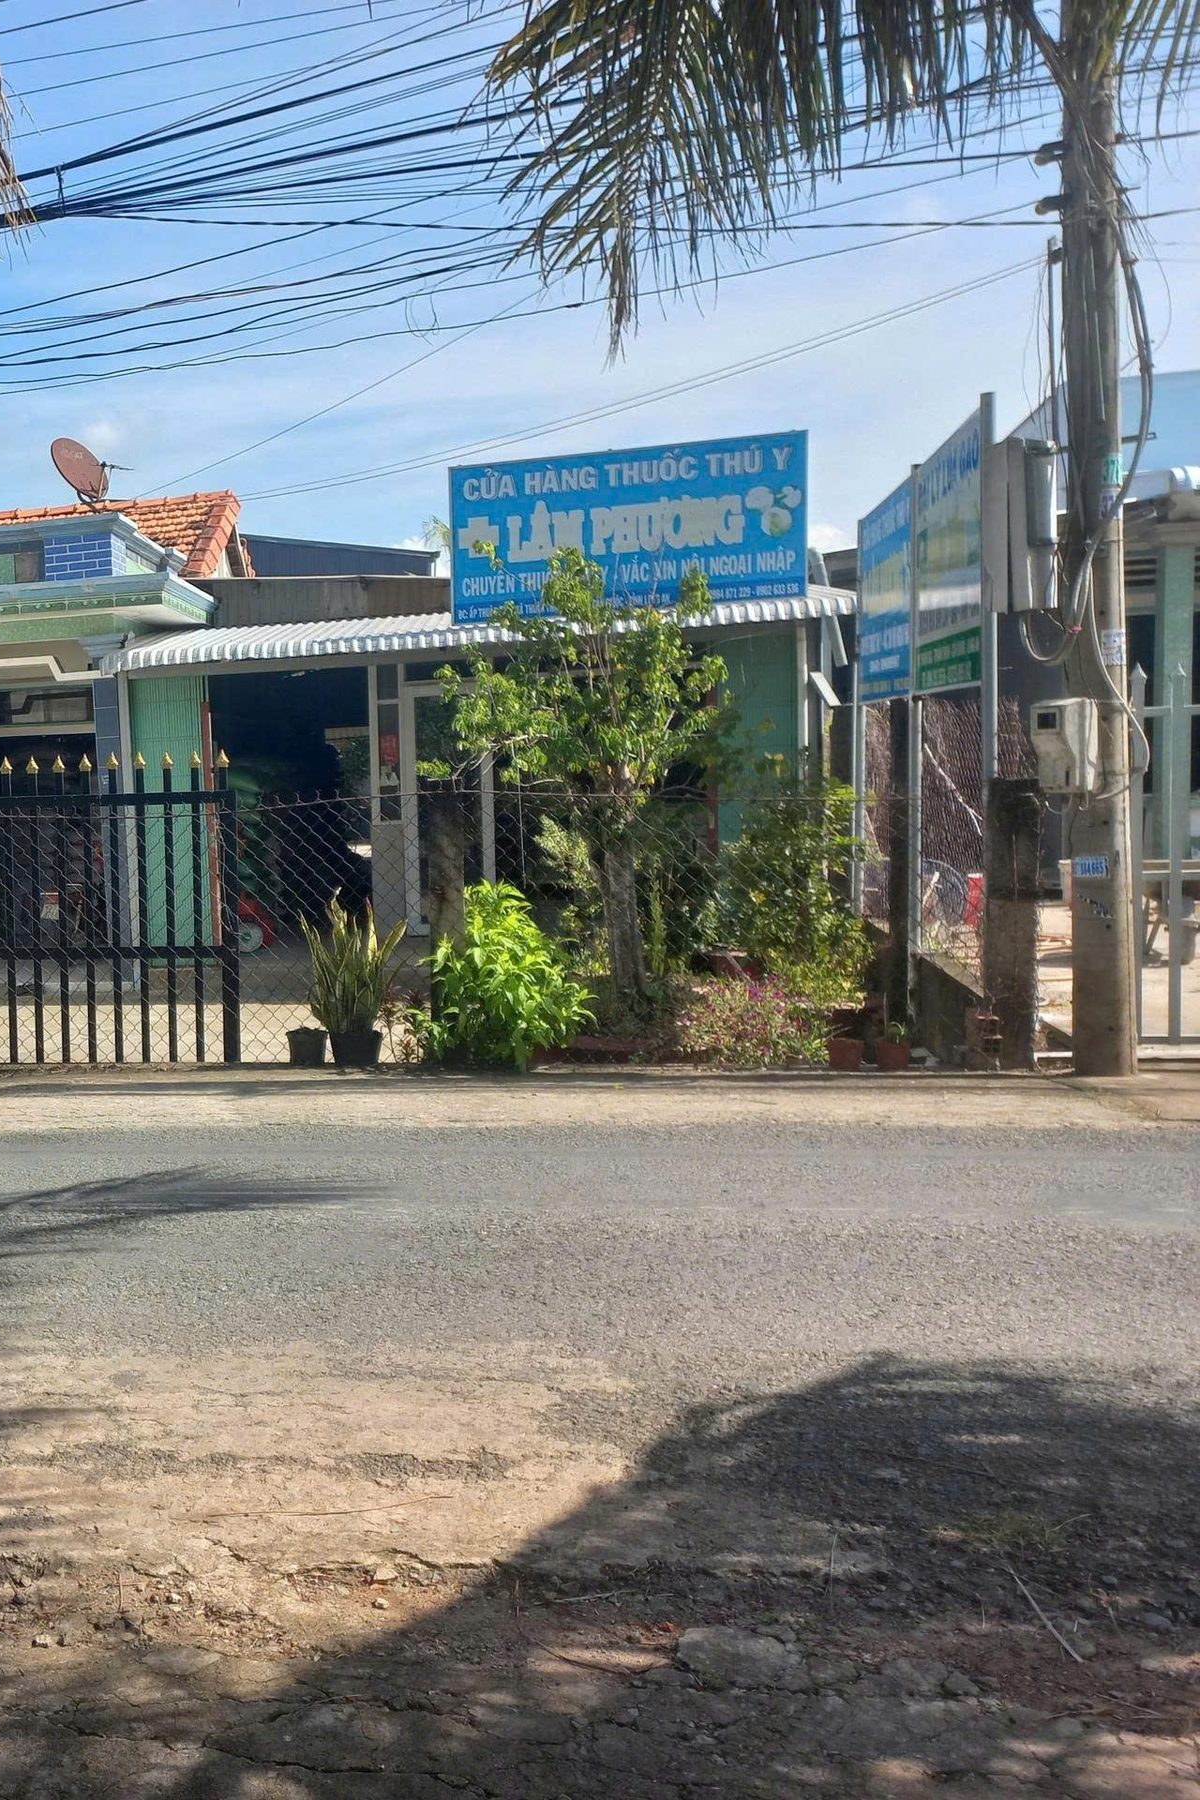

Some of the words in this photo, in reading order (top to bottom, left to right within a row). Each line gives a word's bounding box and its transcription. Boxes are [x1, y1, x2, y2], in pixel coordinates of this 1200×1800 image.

[463, 468, 517, 501] CỬA
[525, 465, 598, 495] HÀNG
[604, 449, 699, 488] THUỐC
[771, 446, 793, 472] Y
[507, 500, 584, 563] LÂM
[590, 494, 745, 555] PHƯƠNG
[462, 569, 515, 597] CHUYÊN
[621, 555, 650, 583] VẮC
[710, 553, 751, 578] NGOẠI
[757, 545, 796, 576] NHẬP
